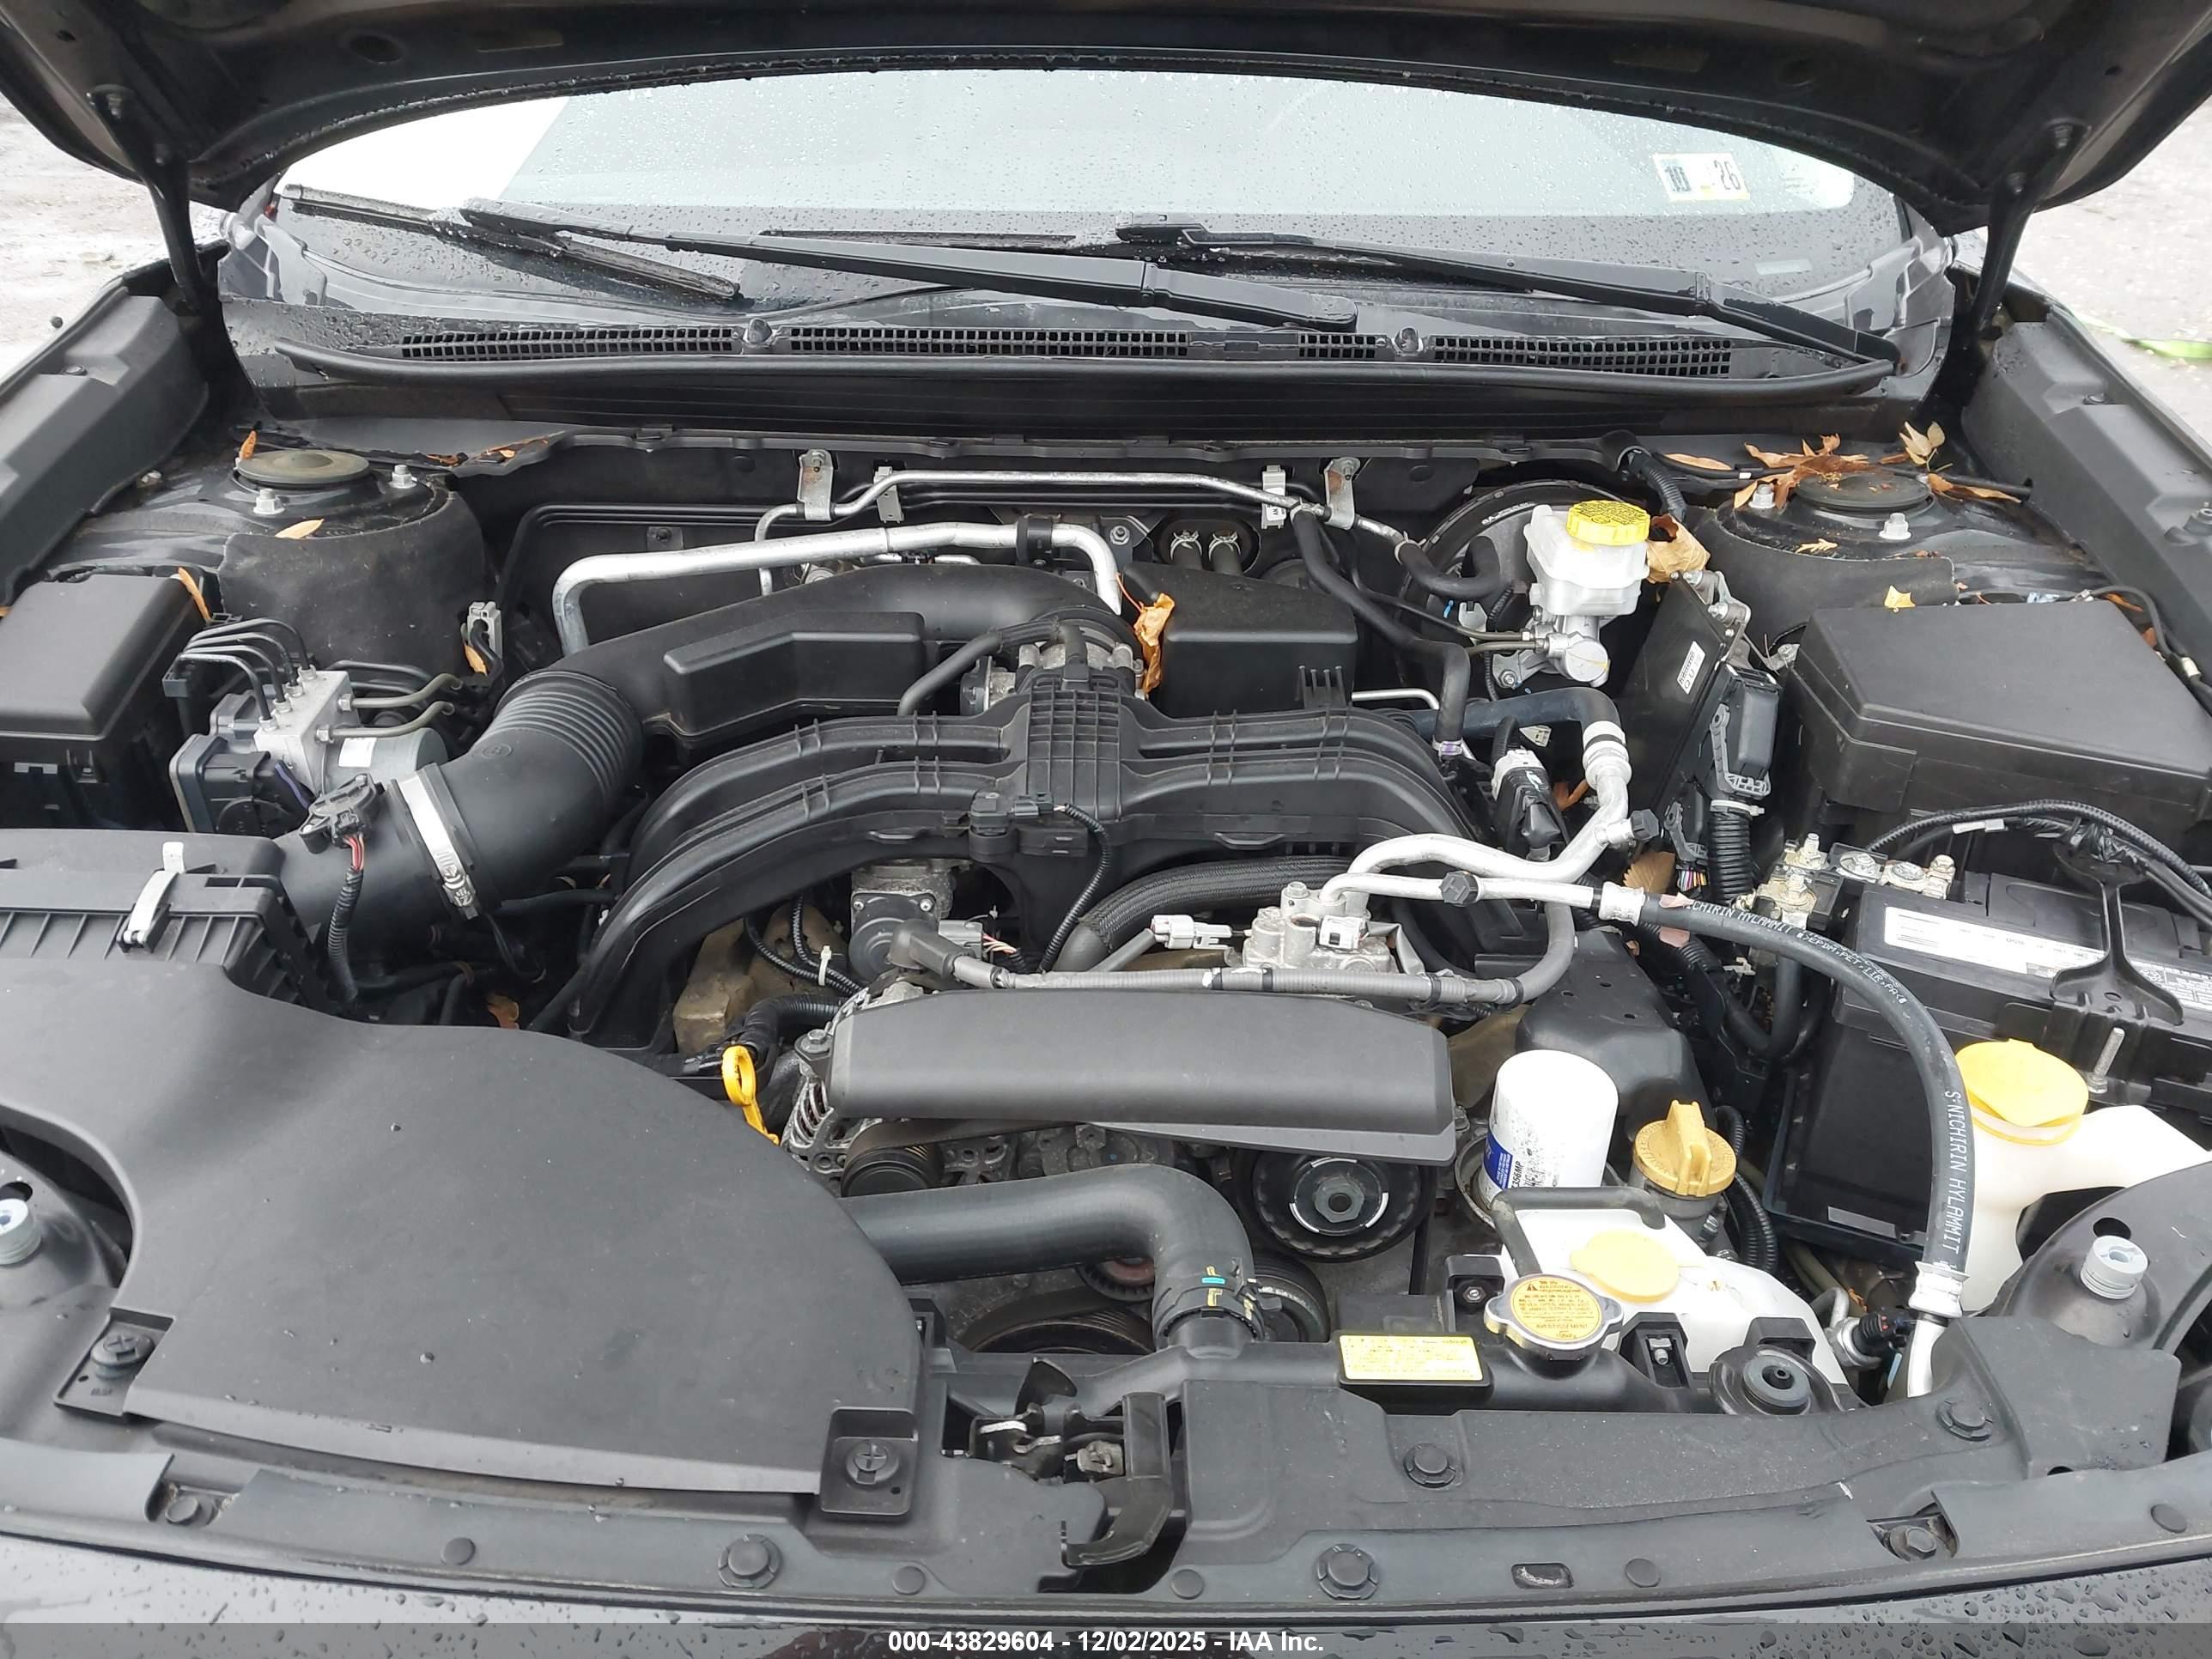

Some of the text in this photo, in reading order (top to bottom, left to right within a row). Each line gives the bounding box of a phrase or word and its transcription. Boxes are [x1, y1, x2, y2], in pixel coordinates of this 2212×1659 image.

[1713, 159, 1741, 191] 26
[1686, 901, 1794, 934] CHIRIN HYLAMMIT
[1942, 1179, 1966, 1255] HYLAMMIT
